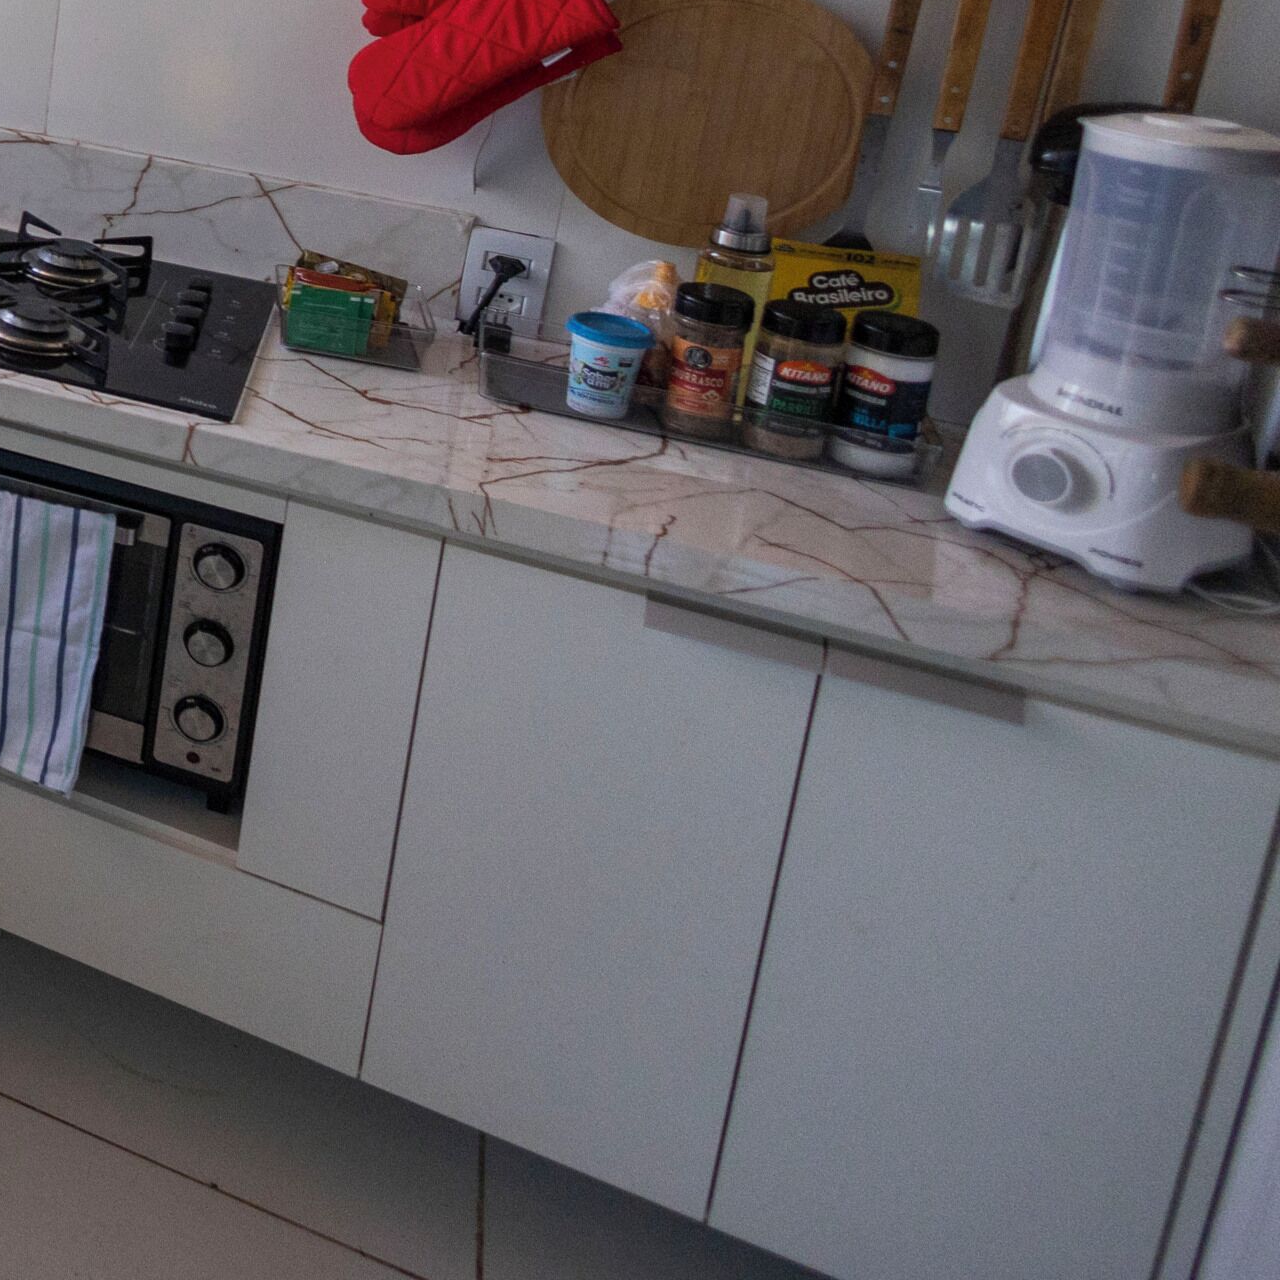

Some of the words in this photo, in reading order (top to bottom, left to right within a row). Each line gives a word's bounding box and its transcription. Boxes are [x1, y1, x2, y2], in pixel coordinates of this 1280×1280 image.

[845, 252, 876, 265] 102
[811, 272, 861, 289] Café
[792, 288, 889, 305] Brasileiro
[778, 367, 831, 383] KITANO
[846, 372, 892, 393] KITANO
